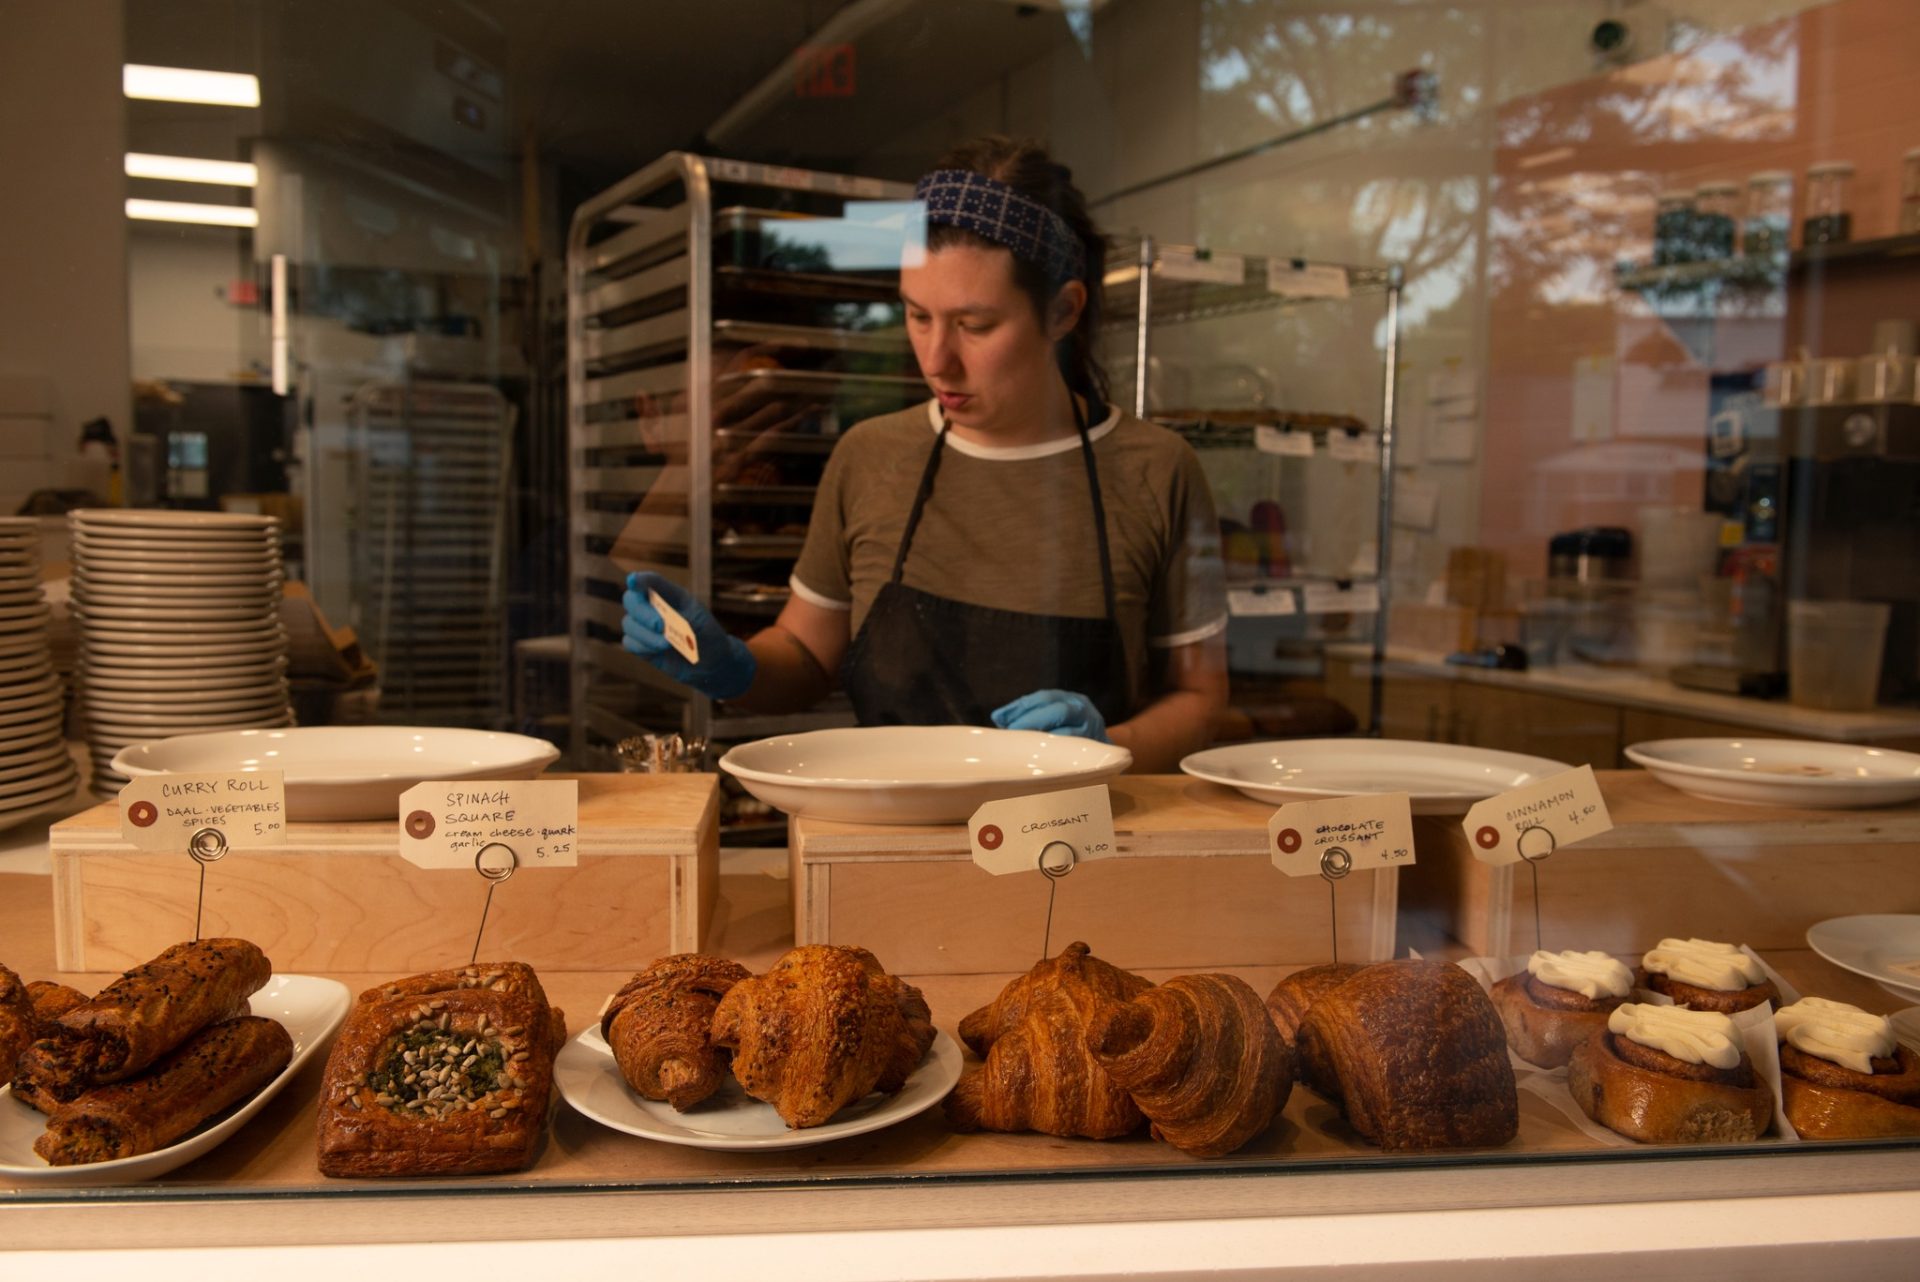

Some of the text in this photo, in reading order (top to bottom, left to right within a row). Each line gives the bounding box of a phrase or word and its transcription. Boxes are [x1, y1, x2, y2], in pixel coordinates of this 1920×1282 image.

[162, 778, 270, 798] CURRY ROLL
[446, 790, 511, 808] SPINACH
[166, 802, 280, 817] DAAL VEGETABLES
[182, 815, 227, 827] SPICES
[445, 810, 516, 825] SQUARE
[1021, 813, 1090, 834] CROISSANT
[254, 822, 280, 836] 5.00
[445, 829, 483, 838] cream
[489, 827, 535, 838] cheese
[1316, 819, 1385, 834] CHOCOLATE
[450, 837, 486, 852] garlic
[1314, 831, 1385, 846] CROISSANT
[536, 843, 570, 858] 5.25
[1084, 843, 1109, 855] 4.00
[1381, 848, 1409, 860] 4.50
